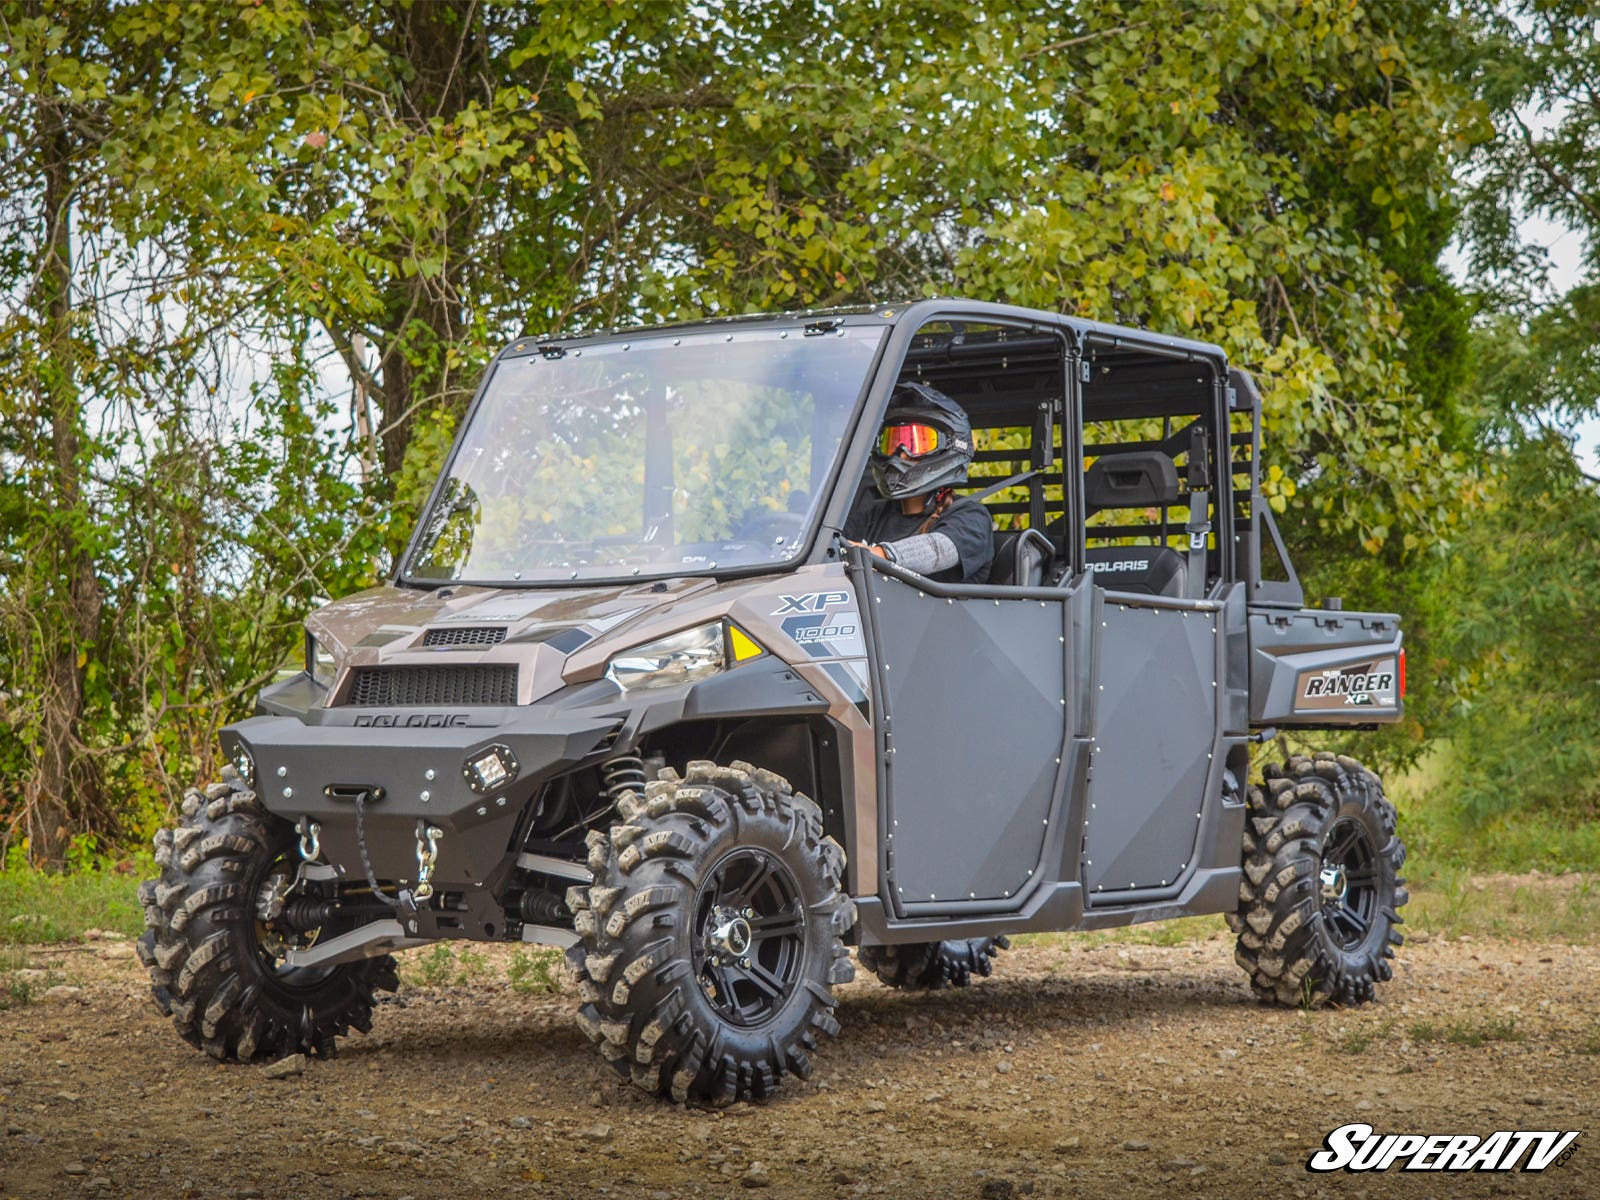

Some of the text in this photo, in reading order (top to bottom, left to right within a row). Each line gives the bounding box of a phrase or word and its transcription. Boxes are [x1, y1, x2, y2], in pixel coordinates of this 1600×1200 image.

[1085, 560, 1149, 573] POLARIS
[769, 591, 850, 615] XP
[795, 625, 857, 640] 1000
[1304, 672, 1393, 698] RANGER
[1344, 693, 1369, 705] XP
